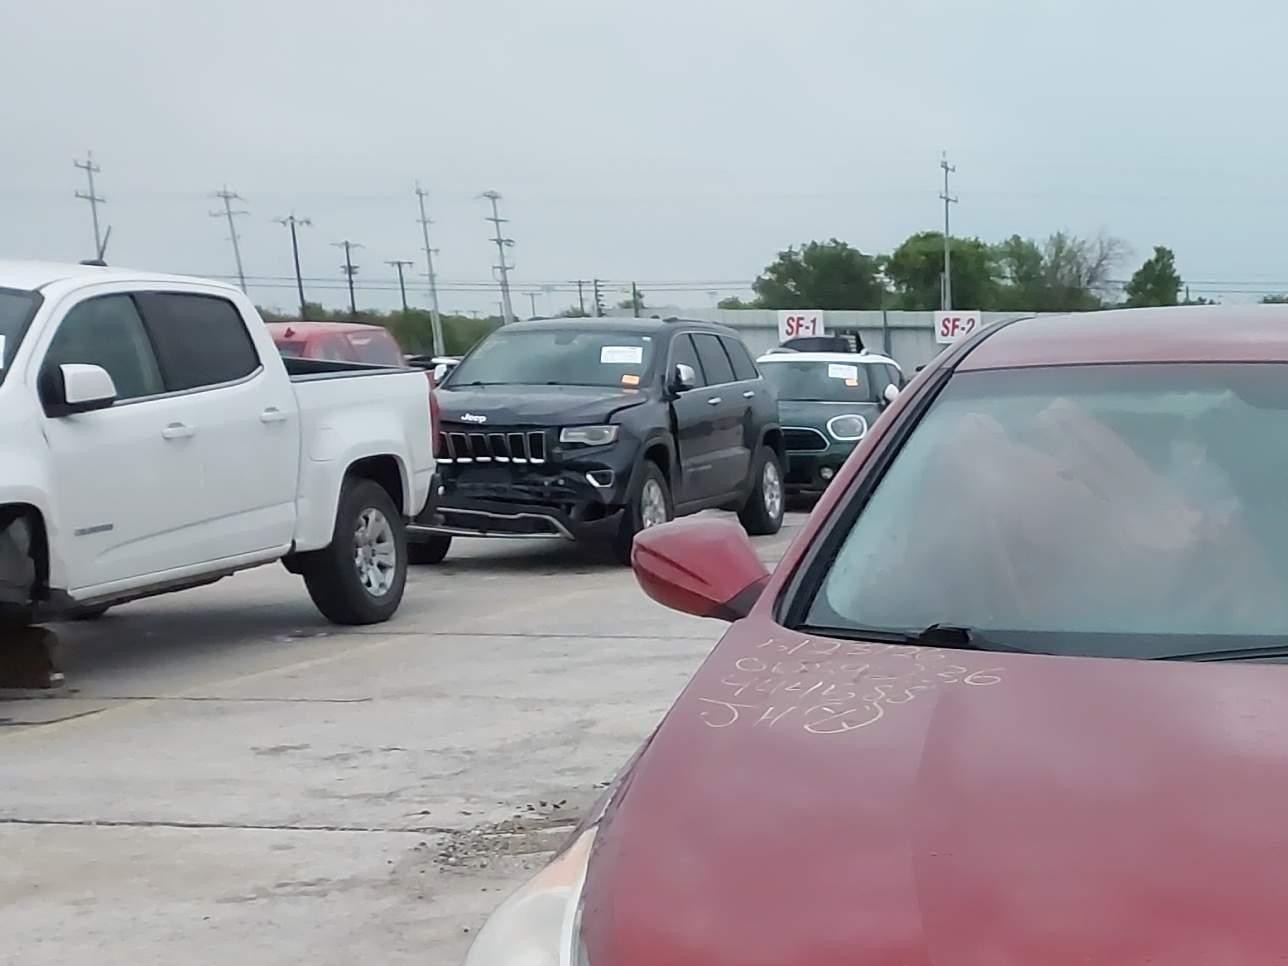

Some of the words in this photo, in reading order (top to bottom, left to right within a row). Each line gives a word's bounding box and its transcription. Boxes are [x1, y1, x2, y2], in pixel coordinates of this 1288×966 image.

[785, 316, 818, 337] SF-1
[940, 317, 976, 338] SF-2
[460, 412, 487, 424] Jeep
